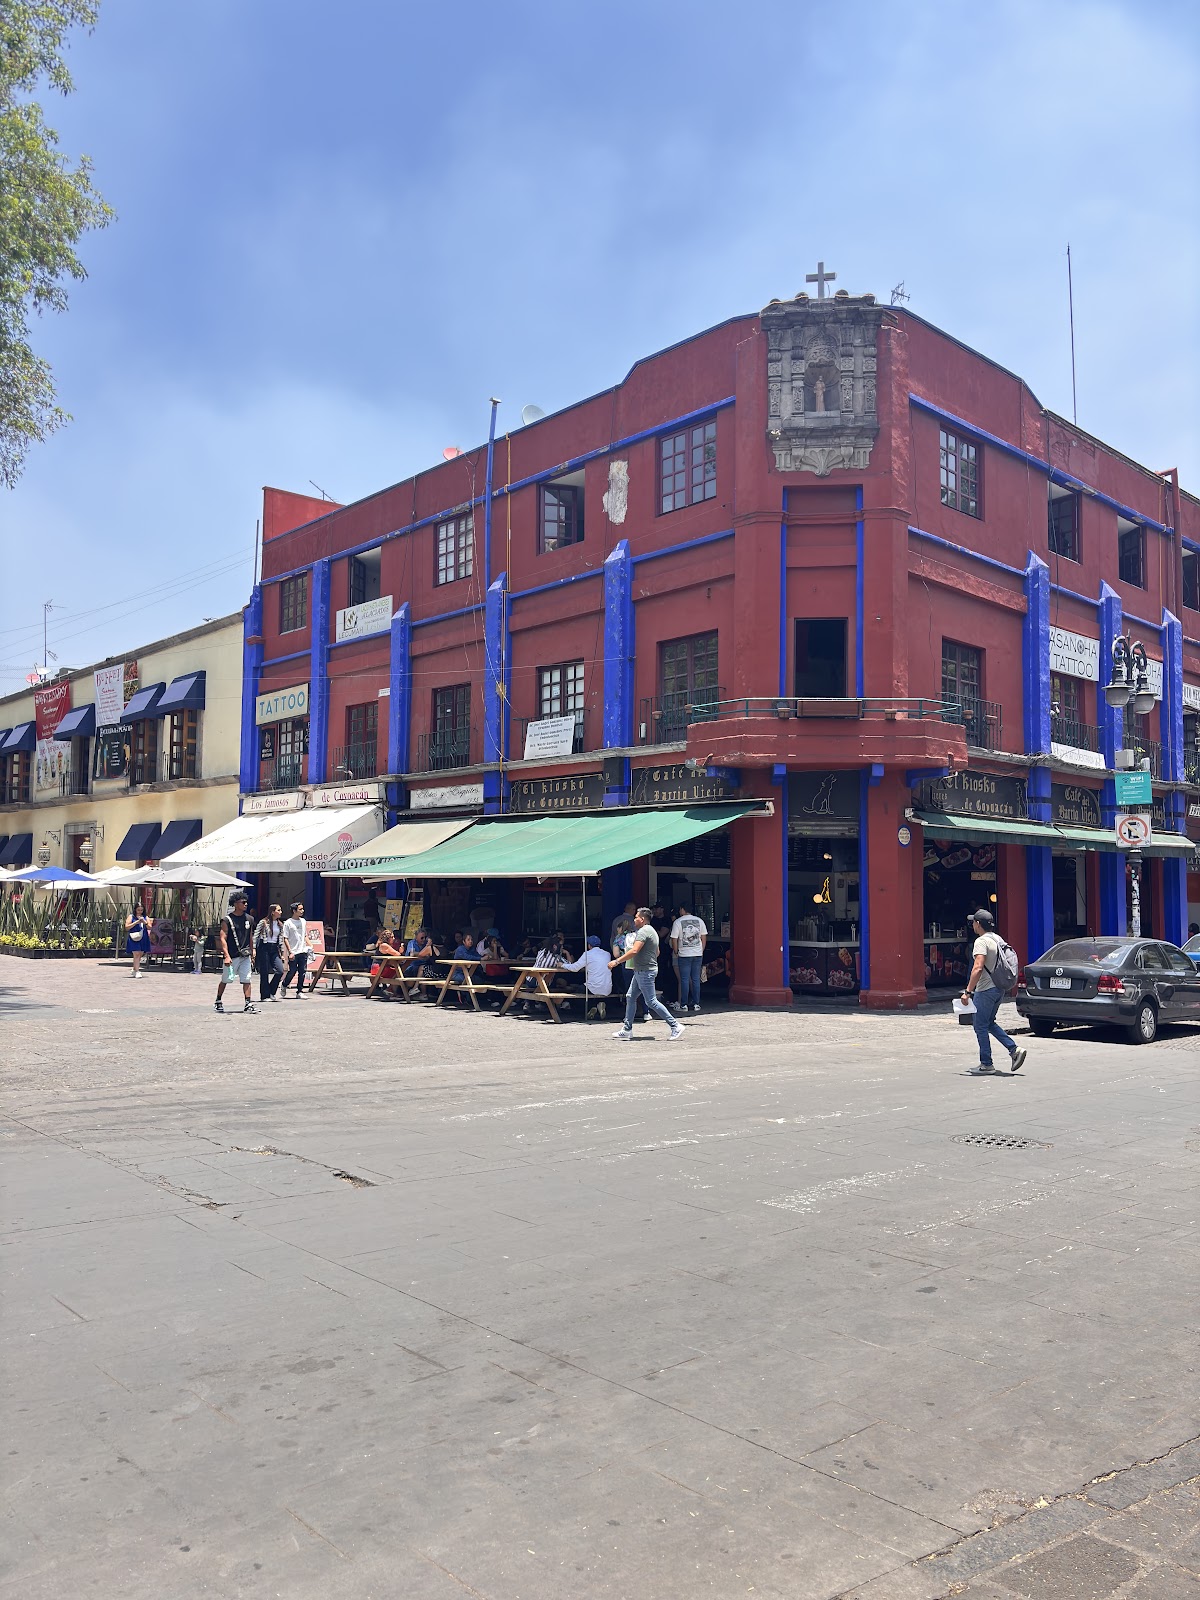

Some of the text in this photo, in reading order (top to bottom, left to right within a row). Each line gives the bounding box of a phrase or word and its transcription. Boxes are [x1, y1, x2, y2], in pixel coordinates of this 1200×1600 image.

[1053, 653, 1094, 678] TATTOO
[259, 691, 305, 716] TATTOO
[652, 766, 685, 781] Café
[251, 799, 262, 810] Los
[264, 798, 289, 809] famosos
[321, 791, 331, 803] de
[654, 786, 688, 801] Barrio
[301, 853, 329, 861] Desde
[305, 861, 327, 870] 1930
